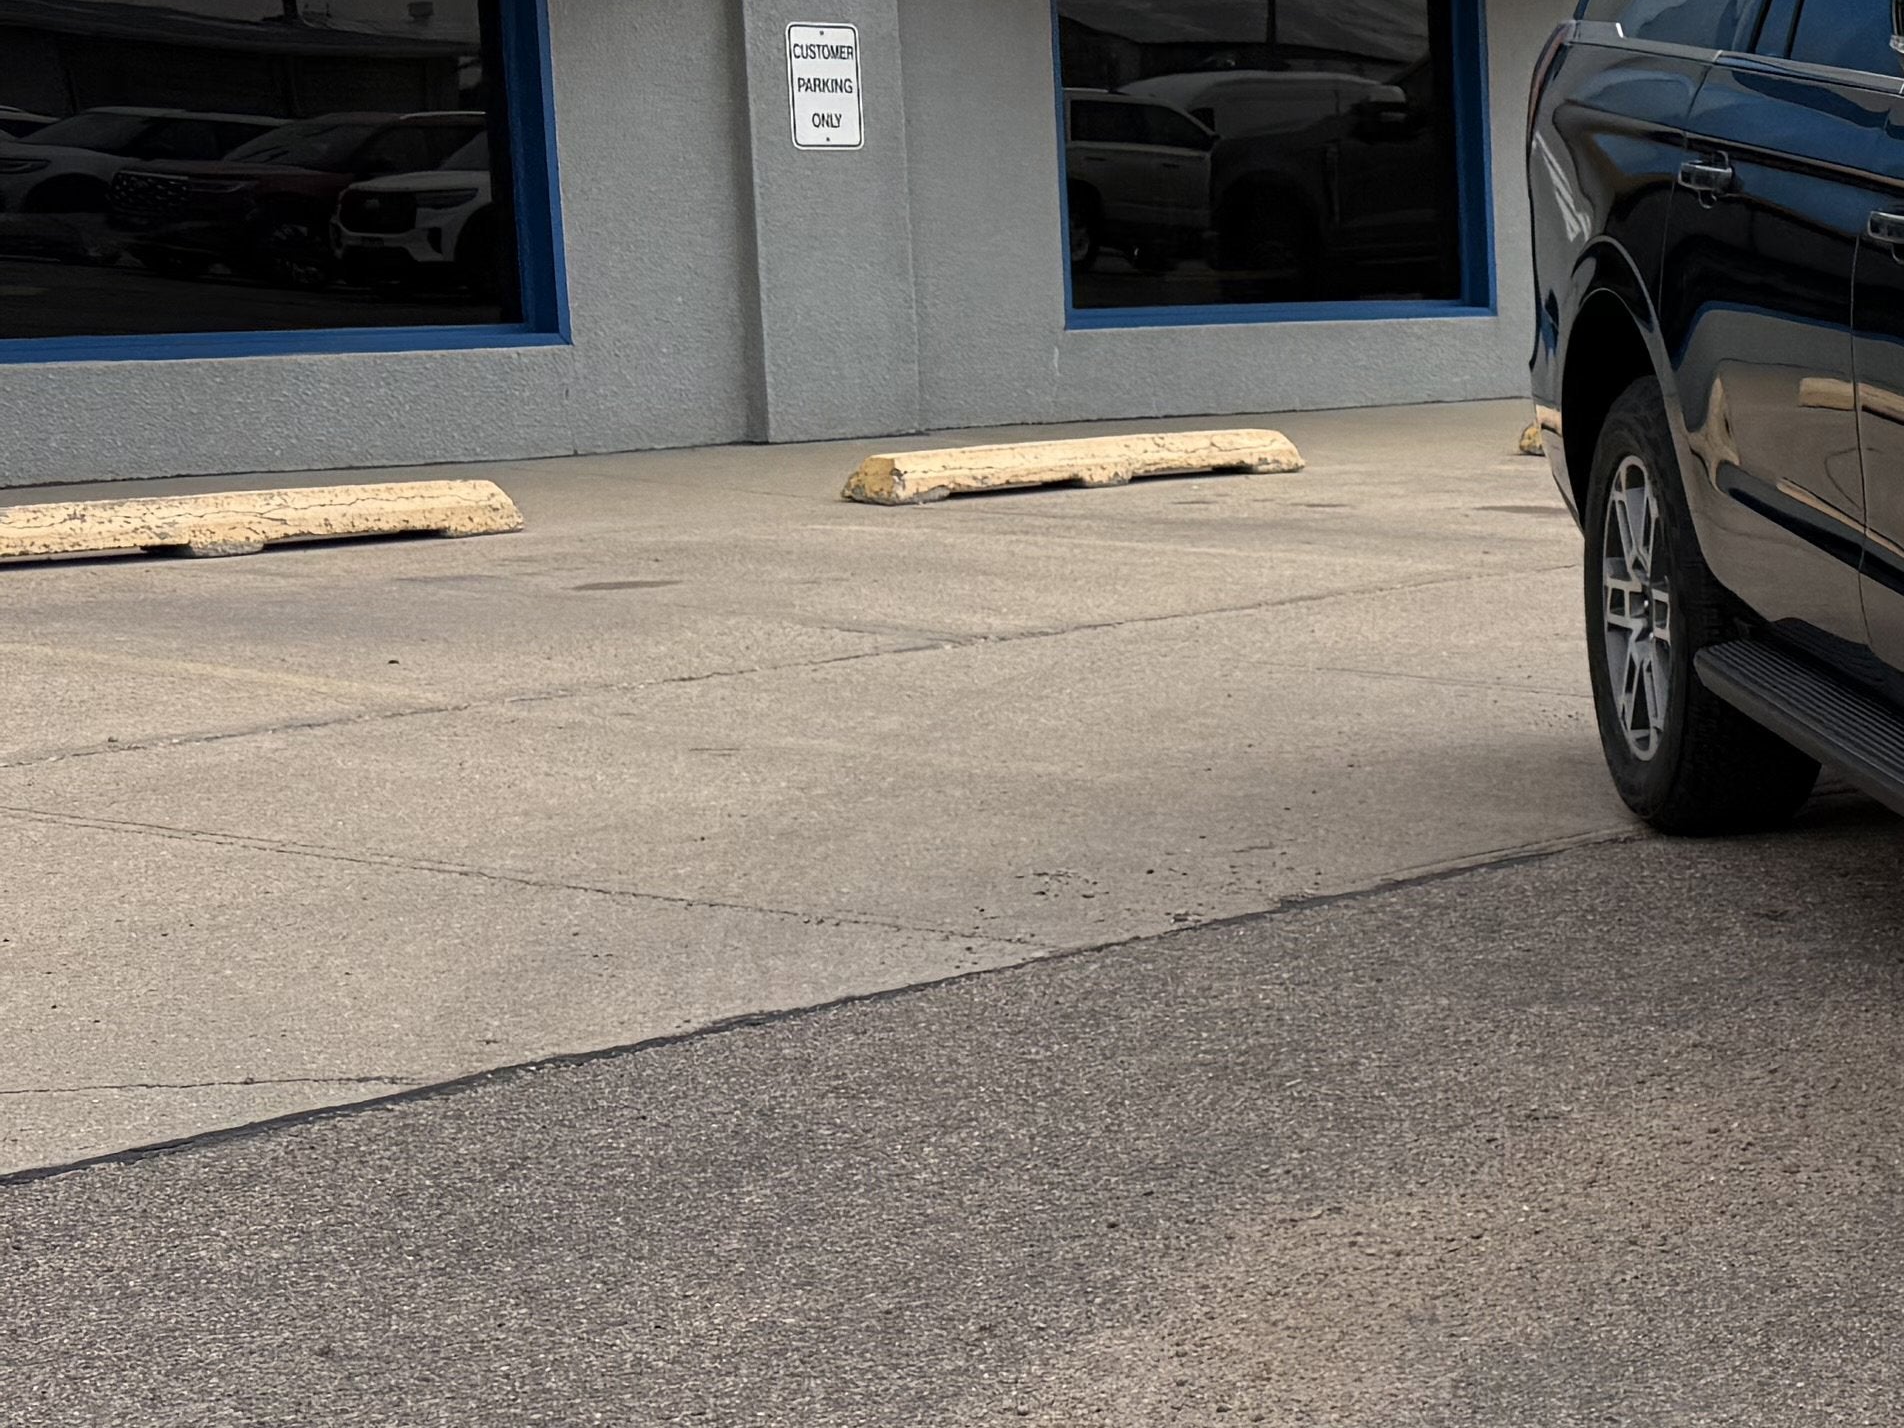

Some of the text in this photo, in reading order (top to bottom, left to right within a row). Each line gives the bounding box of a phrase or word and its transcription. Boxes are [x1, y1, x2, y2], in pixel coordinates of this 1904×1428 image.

[793, 43, 854, 60] CUSTOMER
[797, 77, 853, 94] PARKING
[811, 112, 842, 128] ONLY
